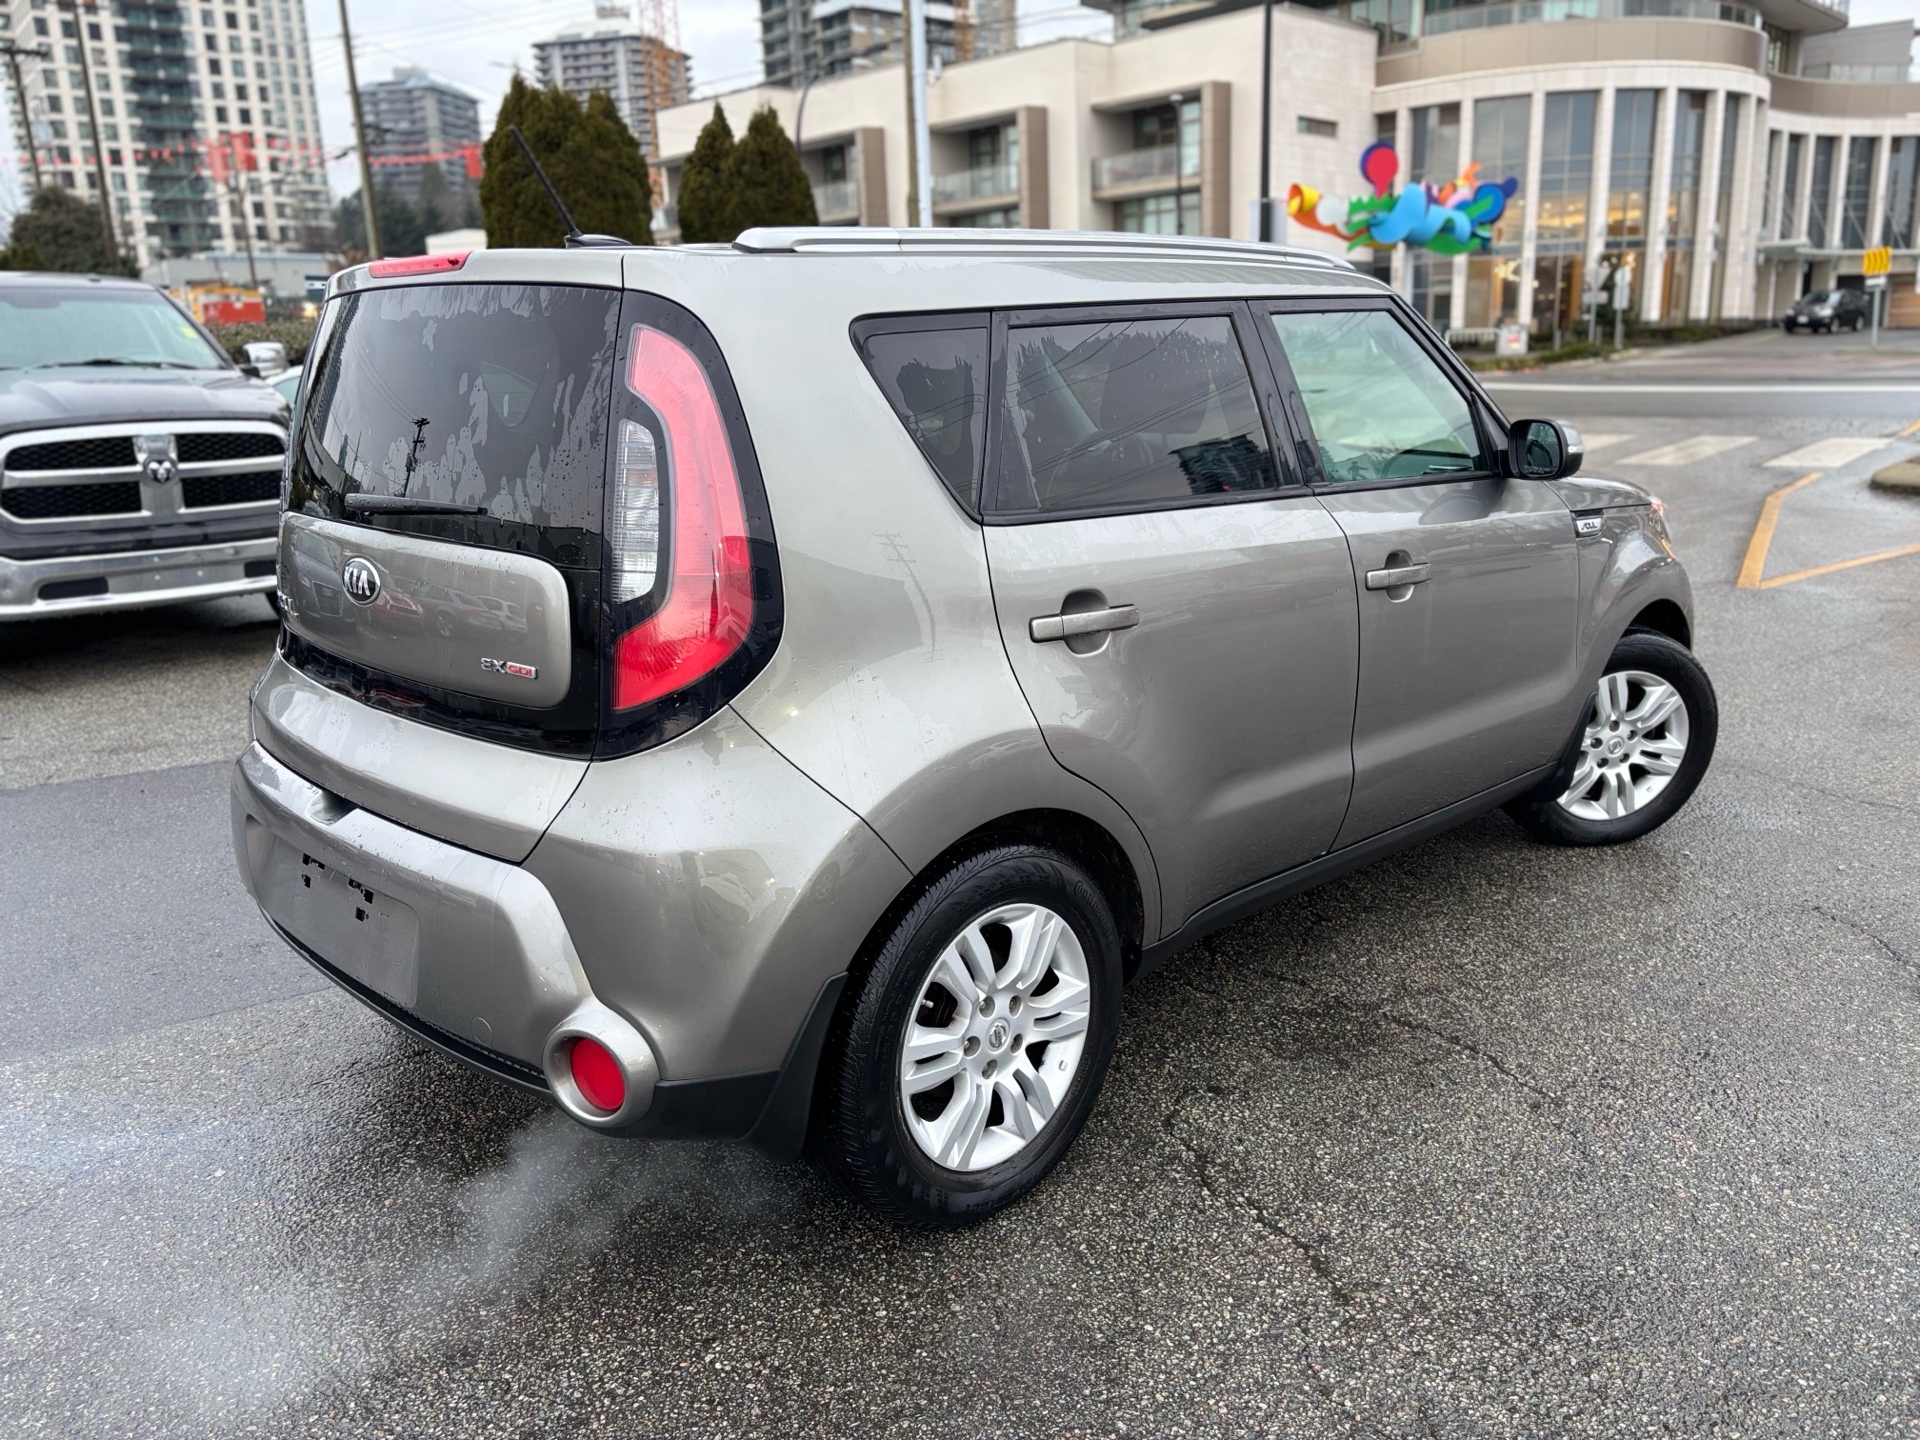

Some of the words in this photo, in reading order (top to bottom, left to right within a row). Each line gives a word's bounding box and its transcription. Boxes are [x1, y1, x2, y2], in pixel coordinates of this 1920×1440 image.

[343, 565, 371, 596] KIA
[480, 657, 506, 674] EX
[507, 663, 534, 678] GDI
